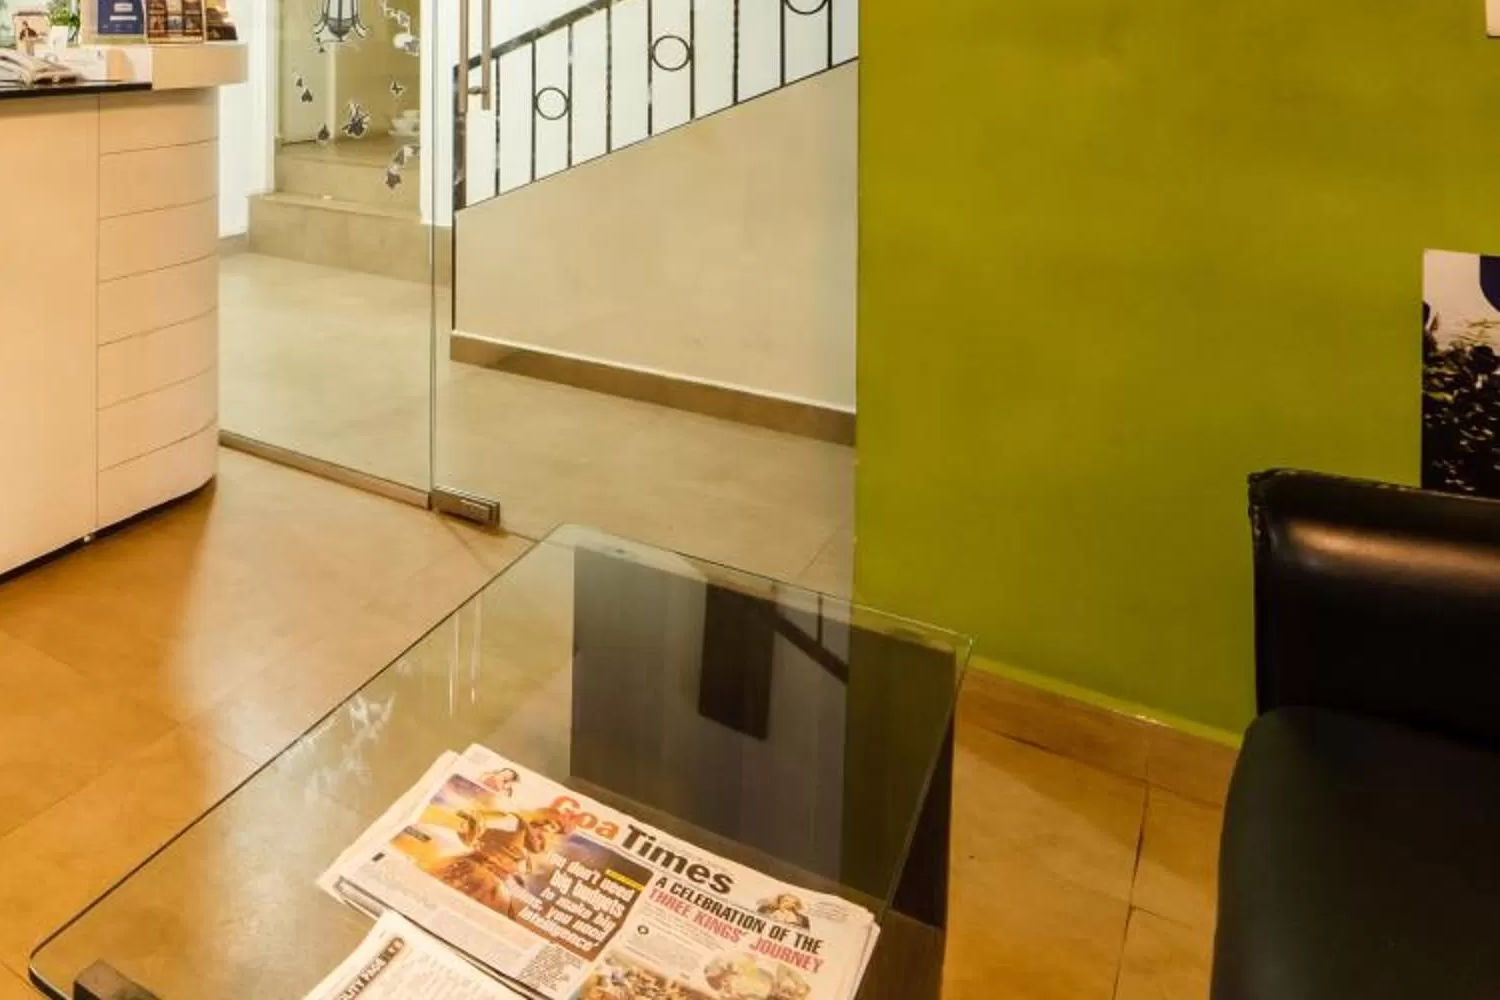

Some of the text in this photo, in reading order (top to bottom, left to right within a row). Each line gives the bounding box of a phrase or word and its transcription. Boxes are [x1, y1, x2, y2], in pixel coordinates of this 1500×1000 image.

[551, 795, 620, 841] Goa
[622, 823, 735, 895] Times
[649, 888, 694, 918] THREE
[749, 935, 825, 974] JOURNEY
[655, 876, 667, 889] A
[669, 882, 767, 934] CELEBRATION
[769, 922, 793, 942] OF
[793, 932, 825, 955] THE
